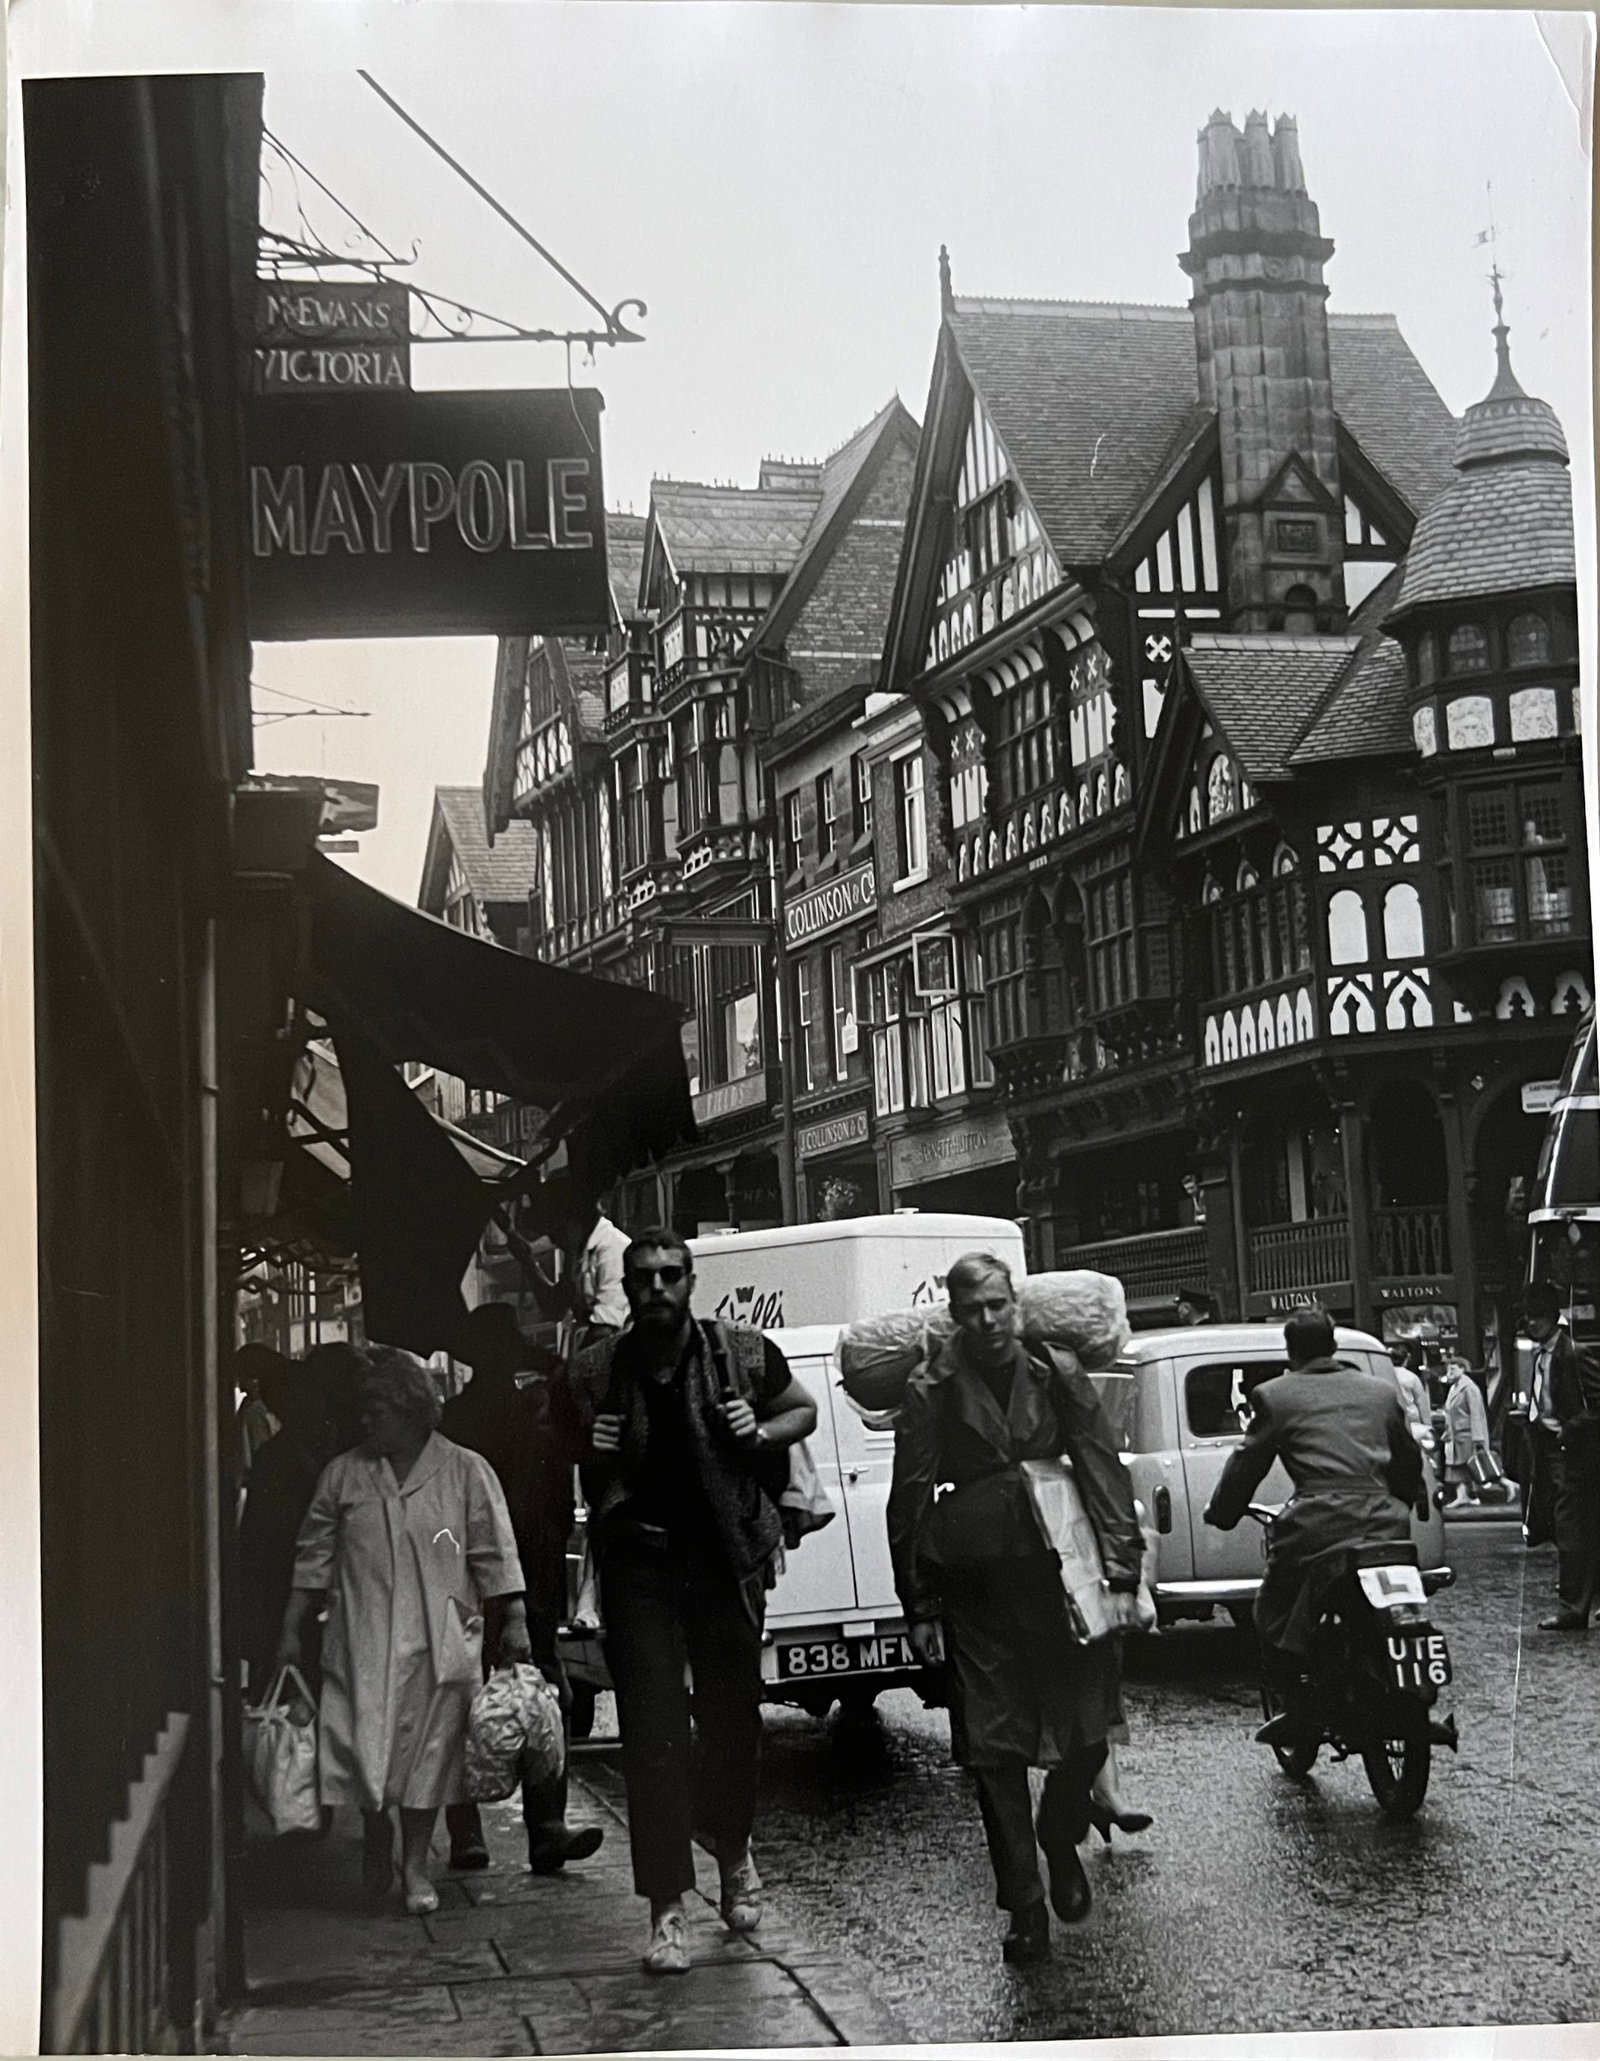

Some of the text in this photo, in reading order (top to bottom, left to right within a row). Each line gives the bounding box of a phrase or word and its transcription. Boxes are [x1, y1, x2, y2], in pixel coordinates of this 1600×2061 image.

[250, 458, 593, 556] MAYPOLE
[788, 881, 852, 939] COLLINSON
[806, 1121, 849, 1150] COLLINSON
[1271, 1290, 1317, 1310] WALTONS
[1381, 1286, 1442, 1298] WALTONS
[1376, 1570, 1409, 1595] L
[788, 1643, 850, 1675] 838
[1387, 1635, 1446, 1661] UTE
[1396, 1660, 1447, 1688] 116
